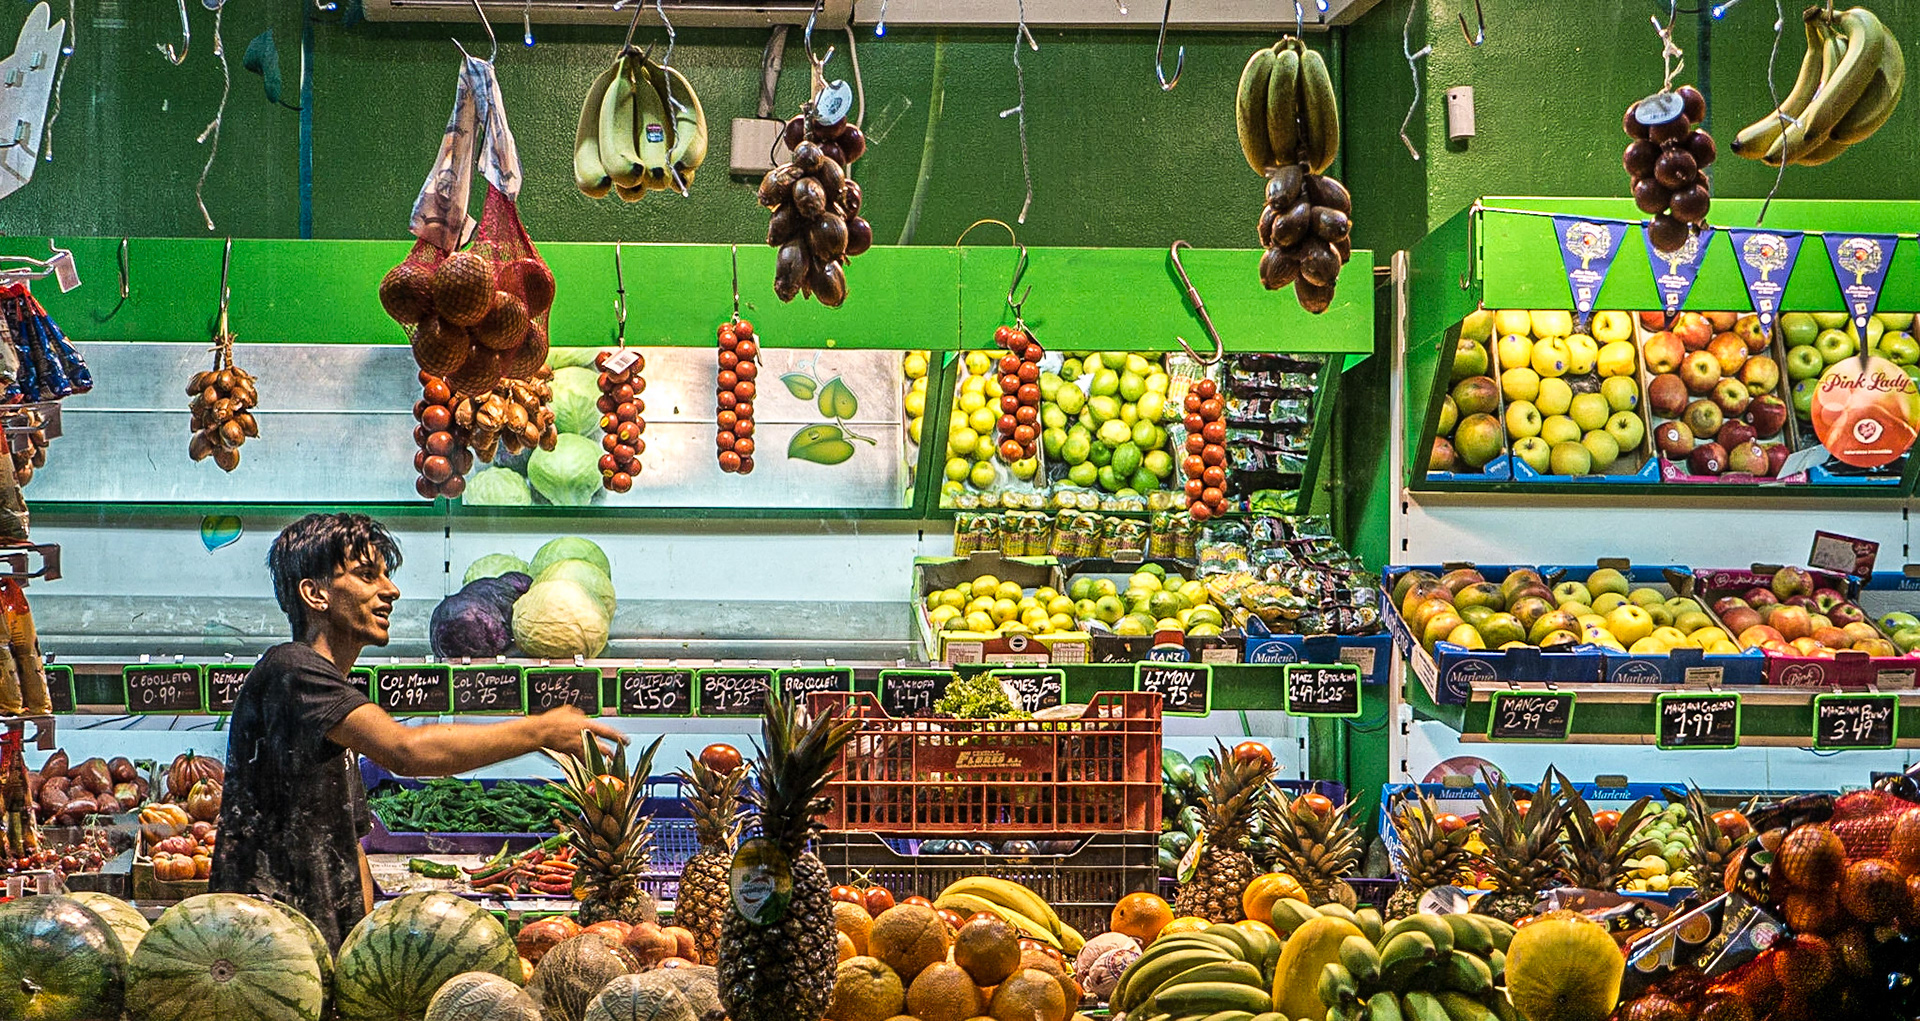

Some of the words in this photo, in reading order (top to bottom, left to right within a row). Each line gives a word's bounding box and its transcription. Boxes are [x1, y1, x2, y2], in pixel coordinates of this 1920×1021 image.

[1822, 373, 1866, 392] Pink
[1867, 372, 1916, 394] Lady
[380, 674, 405, 691] COL
[453, 676, 473, 690] COL
[624, 674, 685, 691] COLIFLOR
[1144, 670, 1195, 686] LIMON
[460, 687, 498, 704] 0.75
[1674, 712, 1714, 738] 1.99
[1830, 717, 1874, 741] 3.49
[1592, 788, 1632, 800] Marlene
